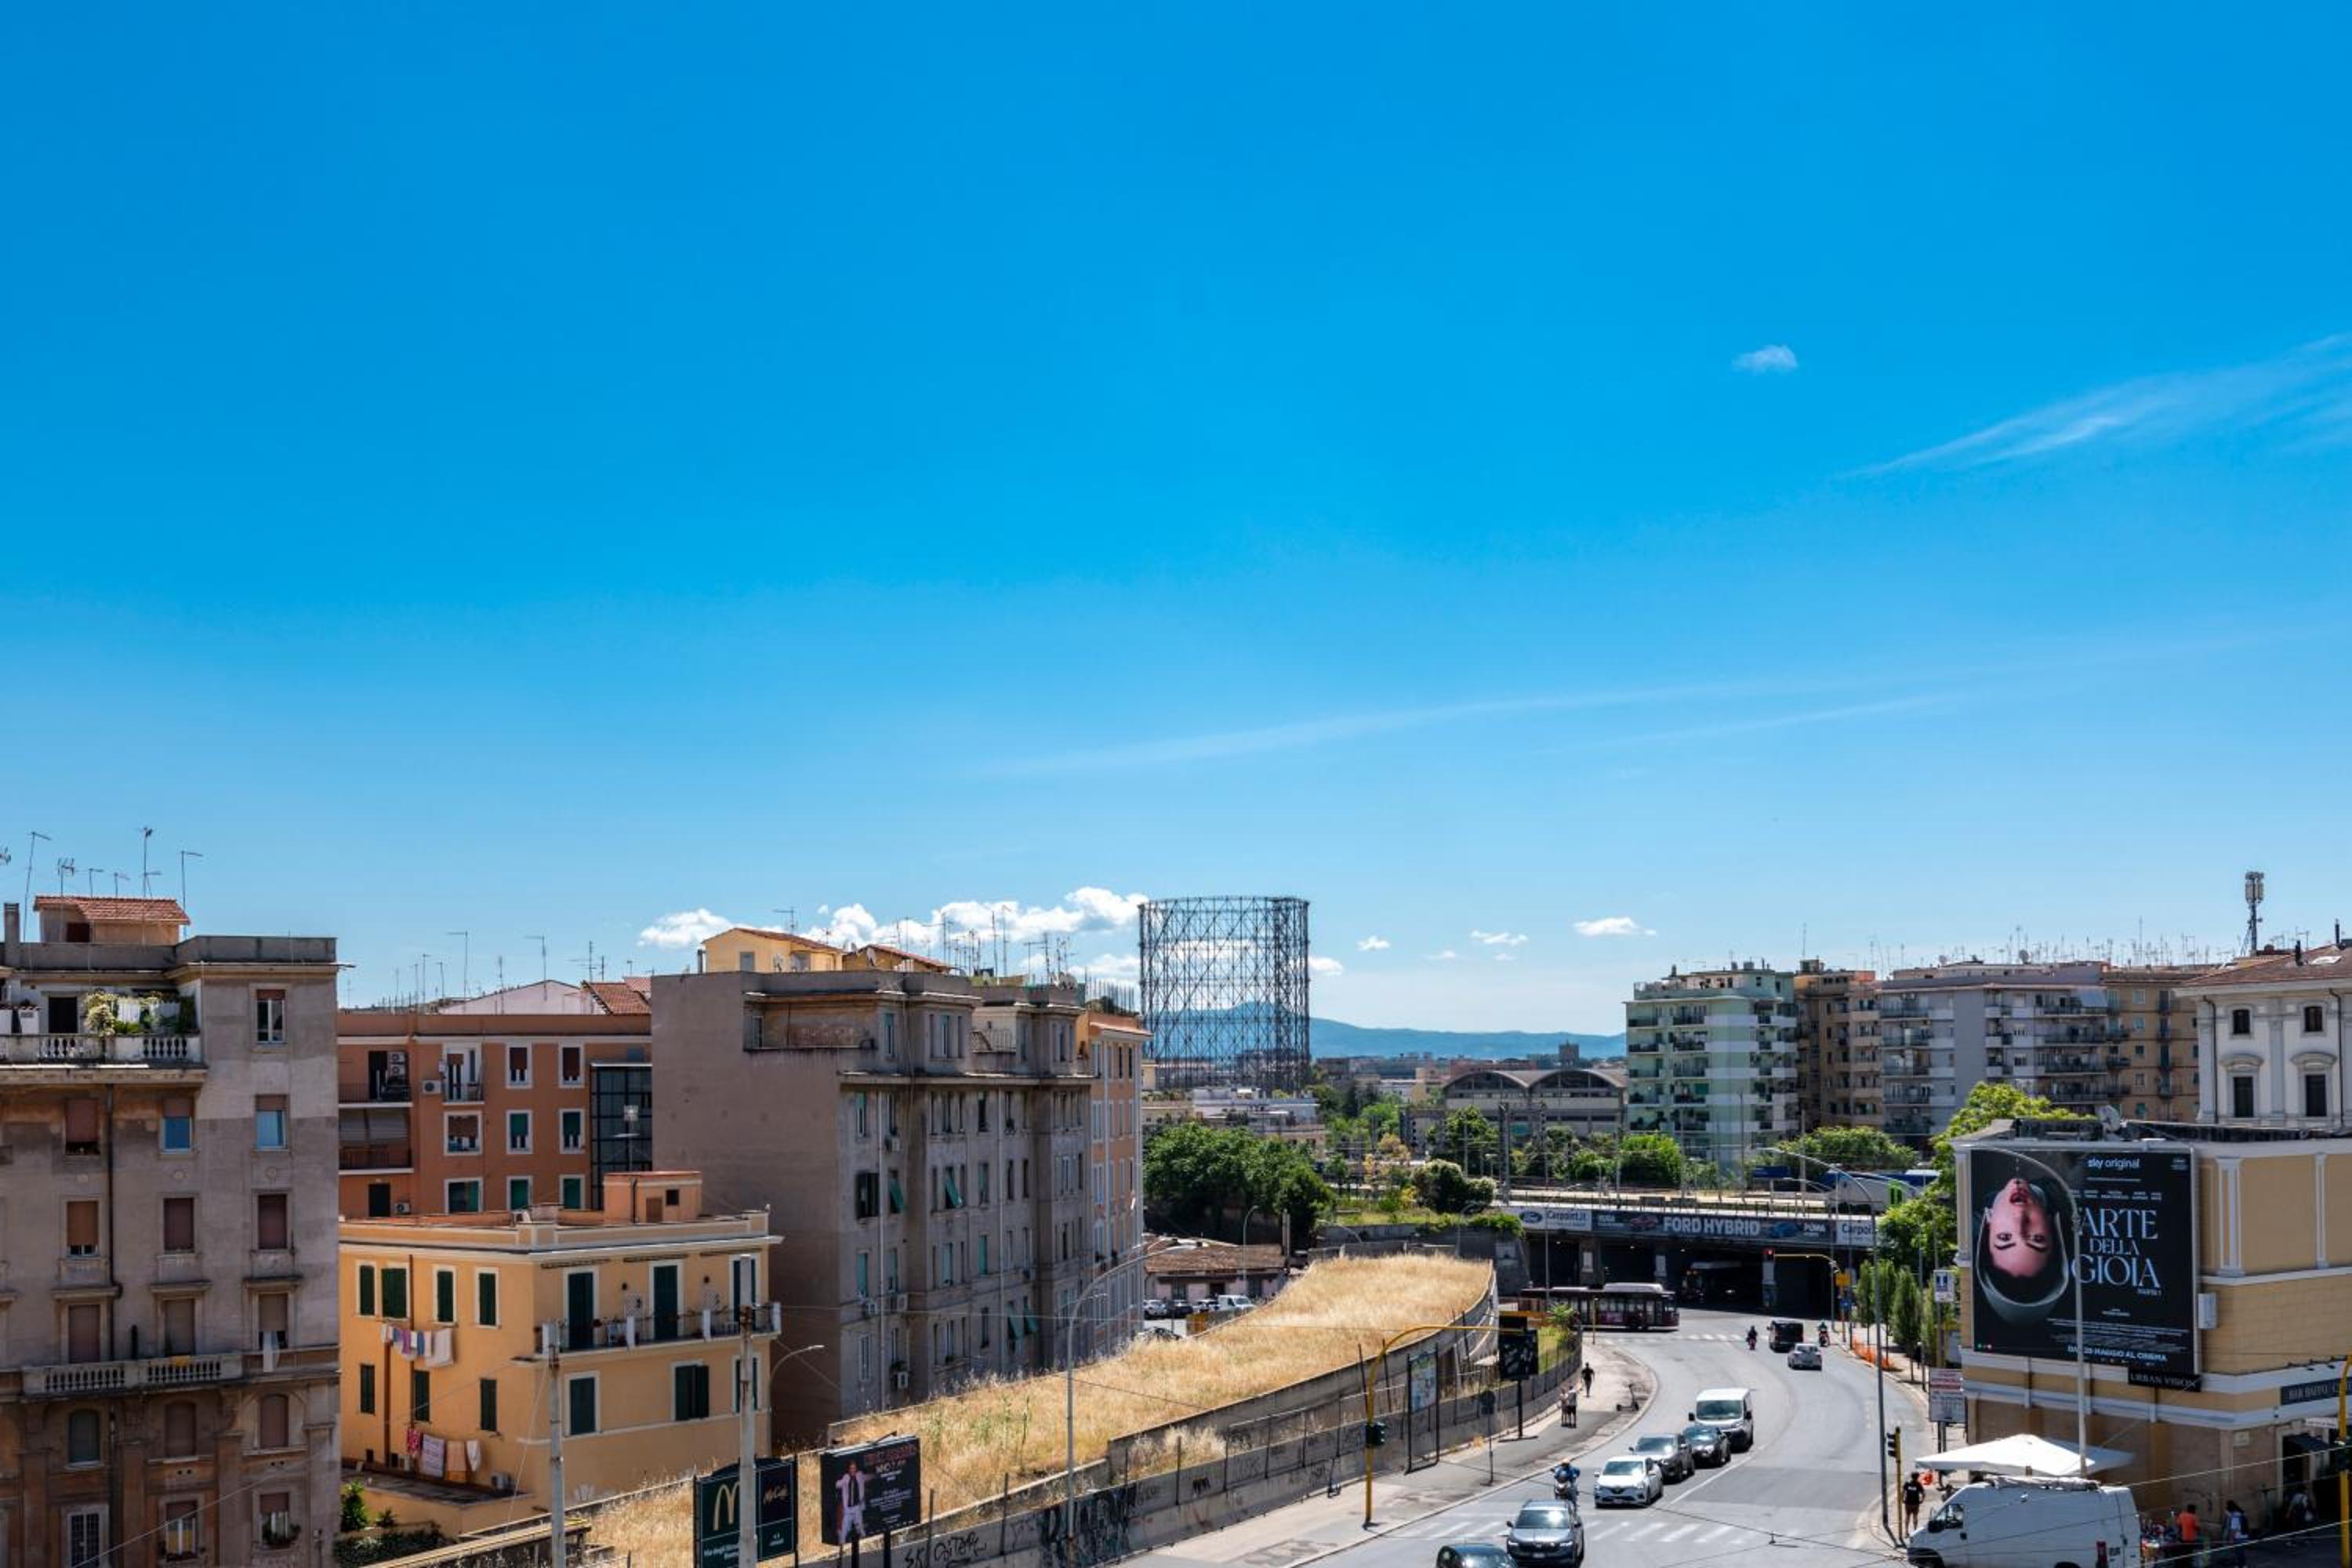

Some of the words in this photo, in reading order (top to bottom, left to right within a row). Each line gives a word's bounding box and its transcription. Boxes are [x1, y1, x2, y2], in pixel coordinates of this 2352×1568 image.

[2087, 1158, 2103, 1169] sky
[2104, 1159, 2140, 1171] original
[1663, 1216, 1702, 1233] FORD
[1704, 1218, 1760, 1236] HYBRID
[2089, 1238, 2140, 1254] DELLA
[2071, 1254, 2160, 1287] GIOIA
